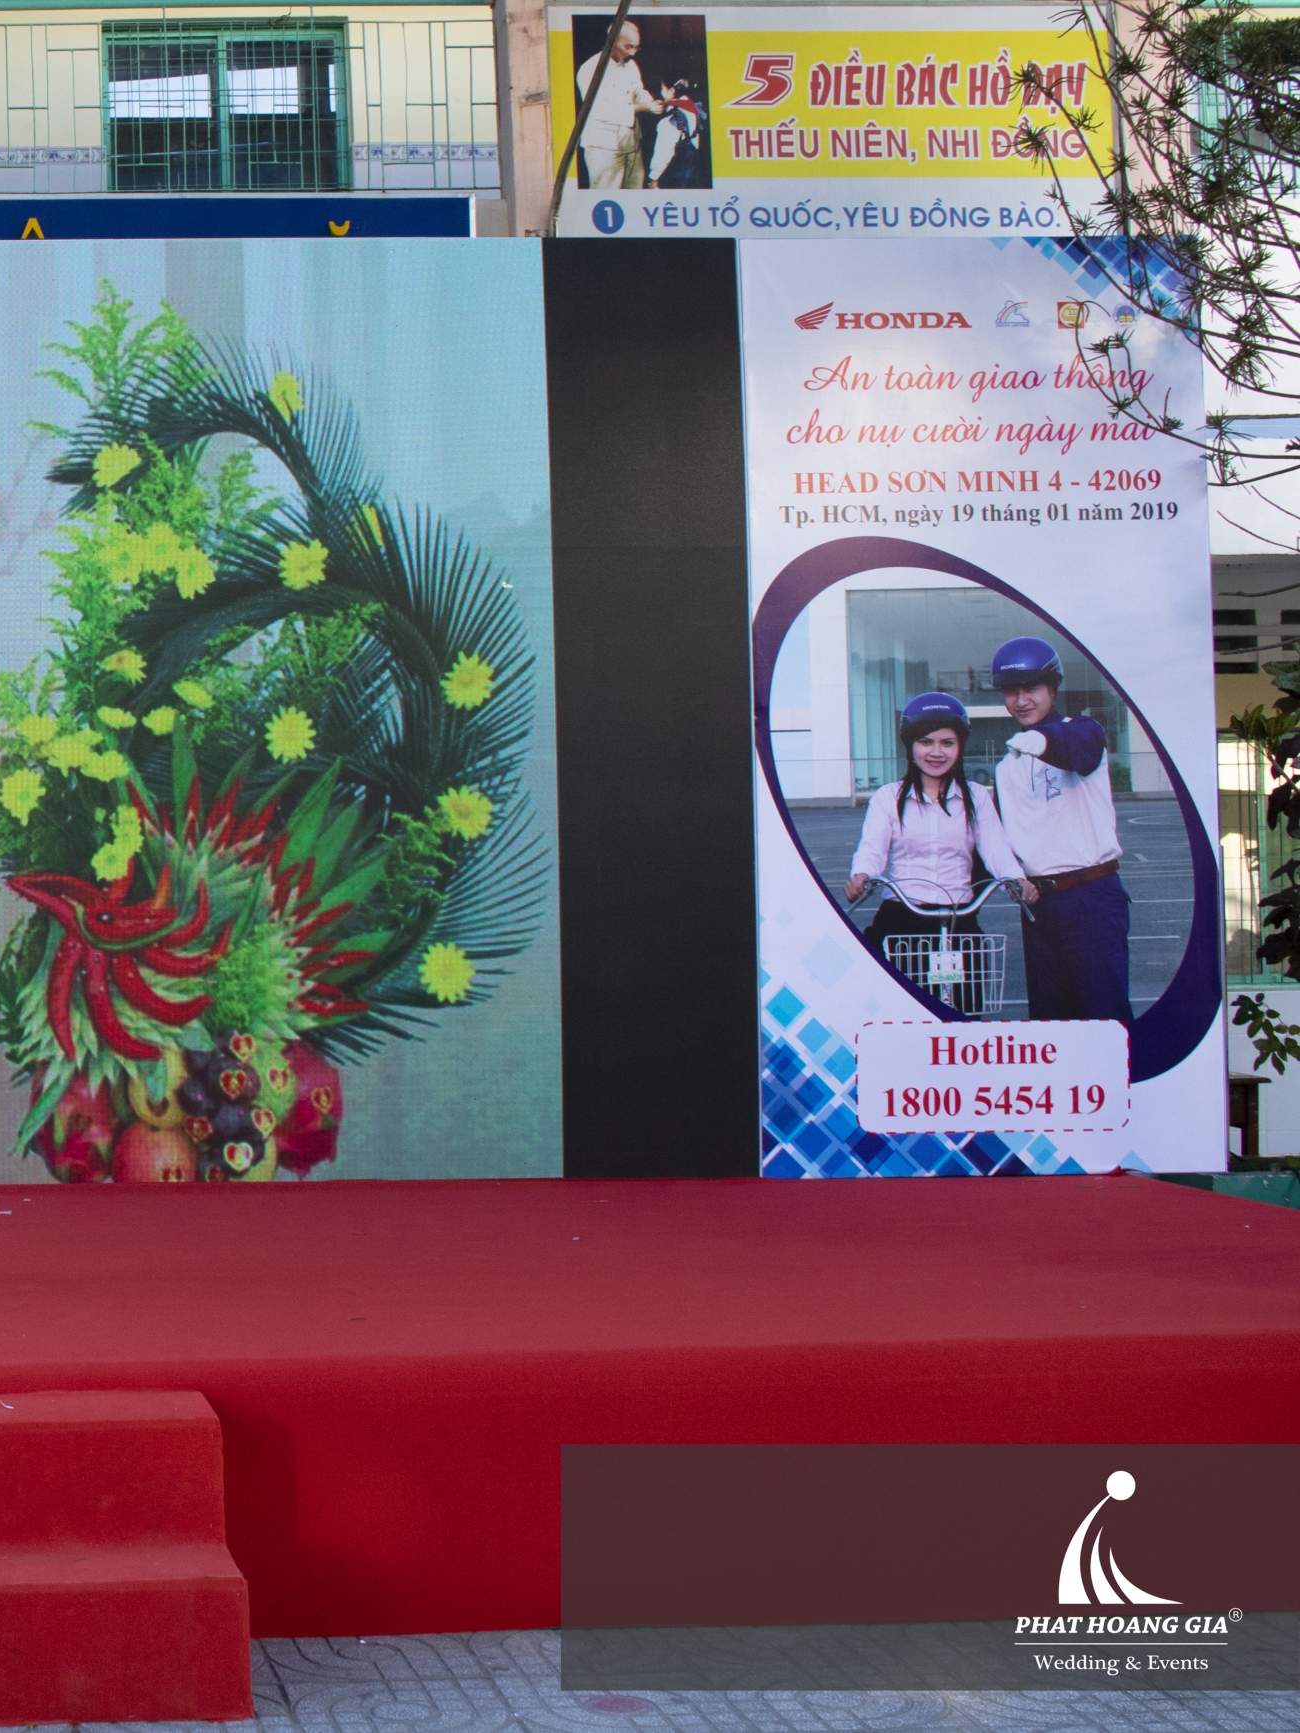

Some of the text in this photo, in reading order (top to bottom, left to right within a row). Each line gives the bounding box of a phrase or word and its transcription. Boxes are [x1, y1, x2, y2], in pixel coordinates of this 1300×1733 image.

[722, 52, 796, 108] 5
[810, 49, 887, 106] ĐIỀU
[895, 54, 960, 106] BÁC
[968, 49, 1012, 107] HỒ
[729, 118, 820, 160] THIẾU
[829, 121, 918, 162] NIÊN,
[927, 126, 980, 159] NHI
[643, 201, 700, 227] YÊU
[708, 196, 741, 228] TỔ
[909, 197, 991, 228] ĐỒNG
[1000, 201, 1060, 228] BÀO.
[835, 312, 972, 329] HONDA
[803, 355, 1154, 403] An toàn giao thông
[787, 408, 1158, 455] cho nụ cười ngày mai
[794, 472, 878, 494] HEAD
[888, 469, 947, 493] SƠN
[958, 470, 1039, 493] MINH
[1049, 470, 1062, 492] 4
[1088, 468, 1161, 491] 42069
[779, 502, 1178, 528] Tp. HCM, ngày 19 tháng 01 năm 2019
[929, 1036, 1057, 1065] Hotline
[884, 1084, 1105, 1117] 1800 5454 19
